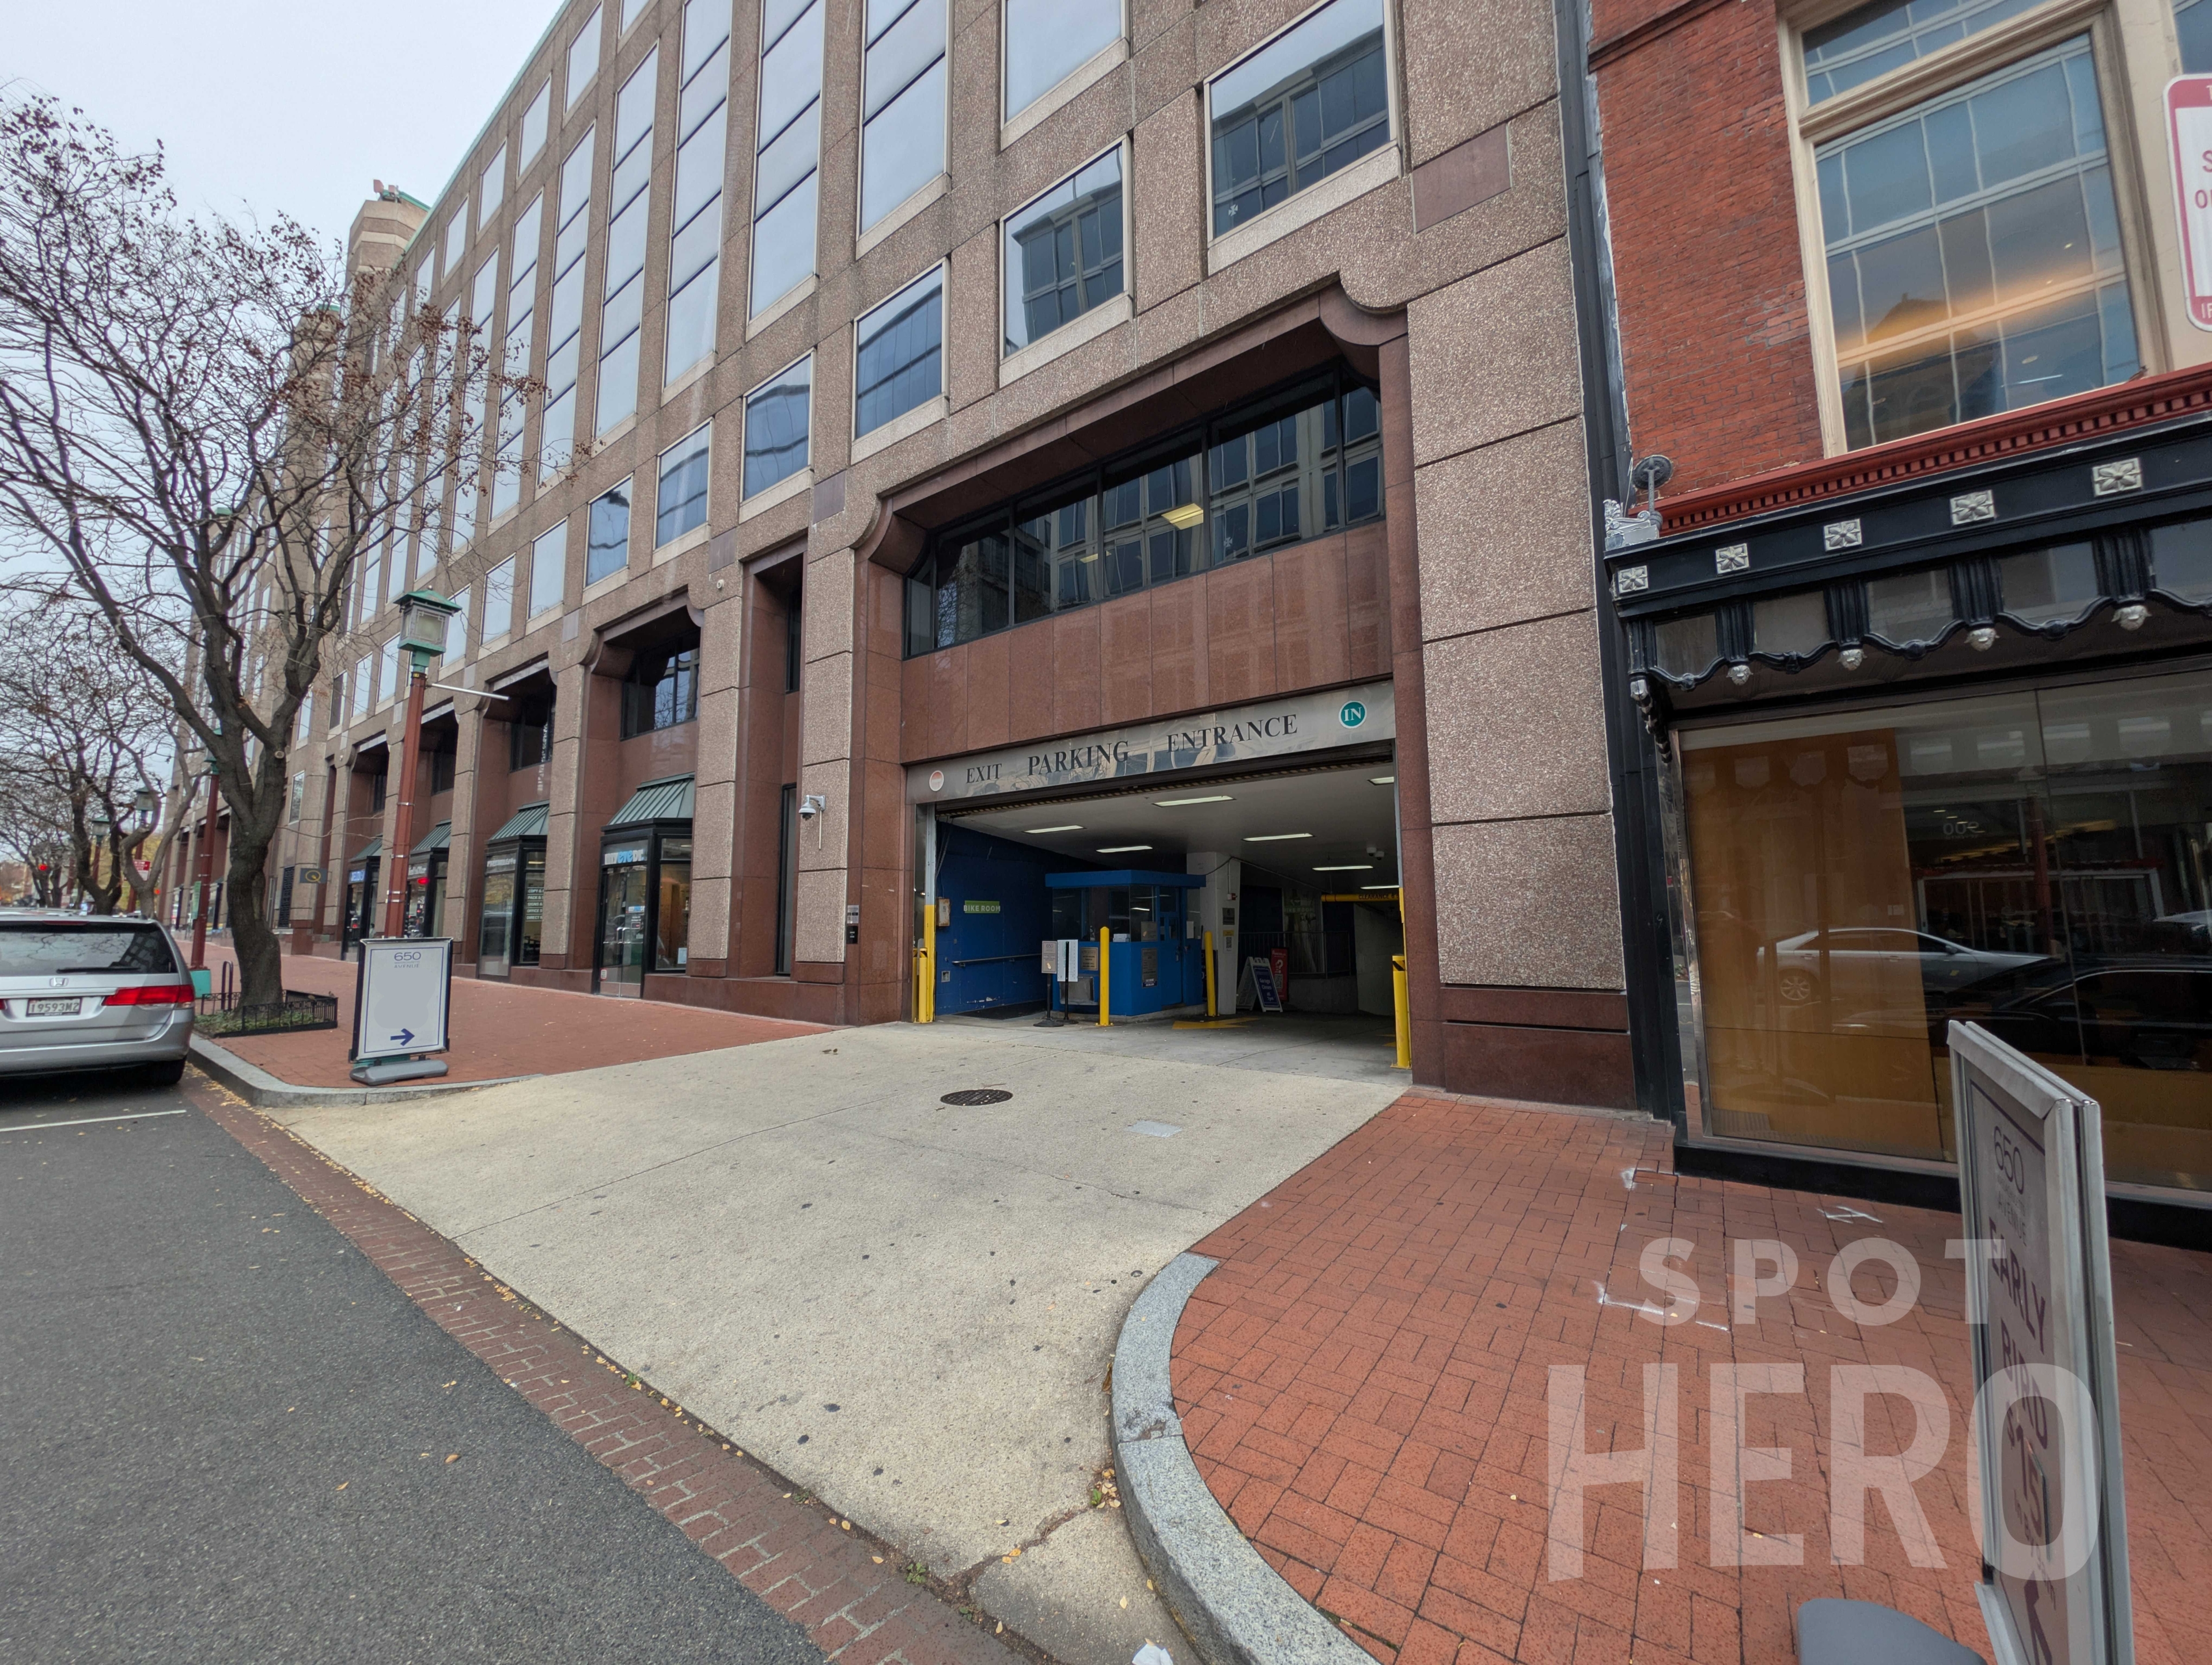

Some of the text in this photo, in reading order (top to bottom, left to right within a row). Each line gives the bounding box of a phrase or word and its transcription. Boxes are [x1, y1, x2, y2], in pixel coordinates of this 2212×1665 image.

[2195, 189, 2212, 209] O
[1344, 707, 1362, 722] IN
[966, 714, 1298, 784] EXIT PARKING ENTRANCE
[394, 951, 422, 961] 650
[1994, 1125, 2024, 1195] 650
[1998, 1191, 2027, 1247] AVENUE
[1989, 1216, 2046, 1356] EARLY
[2001, 1317, 2048, 1450] BIRD
